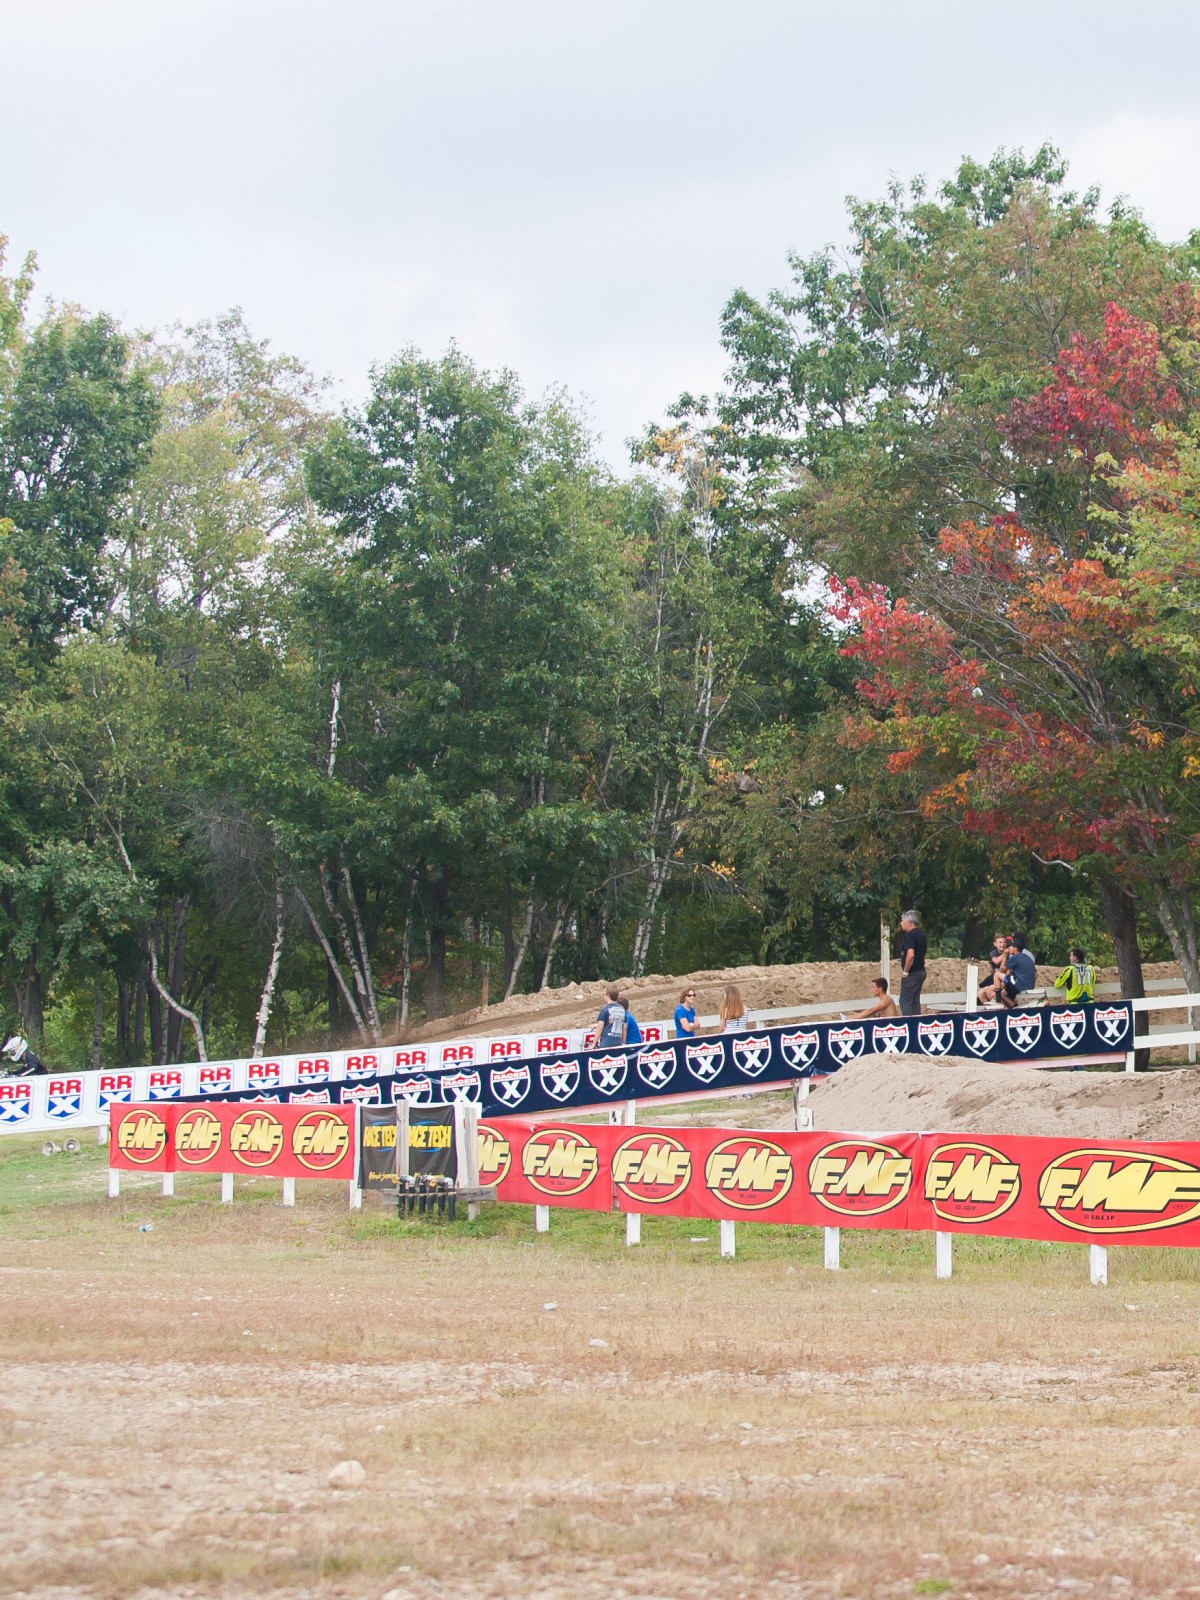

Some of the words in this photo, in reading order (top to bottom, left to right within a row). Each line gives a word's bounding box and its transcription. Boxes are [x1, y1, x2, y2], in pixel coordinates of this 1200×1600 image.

[921, 1025, 951, 1033] RACER
[966, 1022, 996, 1030] RACER
[1010, 1018, 1039, 1026] RACER
[1104, 1020, 1121, 1038] X
[784, 1036, 816, 1044] RACER
[831, 1032, 862, 1040] RACER
[876, 1028, 906, 1036] RACER
[972, 1030, 989, 1048] X
[1015, 1026, 1033, 1045] X
[1059, 1023, 1077, 1041] X
[490, 1041, 522, 1057] RR
[537, 1037, 568, 1052] RR
[735, 1041, 768, 1050] RACER
[838, 1040, 855, 1059] X
[882, 1036, 899, 1054] X
[928, 1034, 946, 1051] X
[396, 1050, 426, 1066] RR
[442, 1045, 474, 1062] RR
[640, 1053, 673, 1062] RACER
[689, 1047, 722, 1056] RACER
[743, 1050, 763, 1069] X
[791, 1044, 809, 1063] X
[248, 1062, 280, 1078] RR
[298, 1059, 330, 1075] RR
[346, 1055, 378, 1071] RR
[543, 1065, 577, 1074] RACER
[590, 1059, 624, 1068] RACER
[648, 1061, 667, 1081] X
[696, 1055, 716, 1074] X
[150, 1071, 182, 1087] RR
[200, 1066, 231, 1082] RR
[443, 1078, 477, 1087] RACER
[493, 1072, 527, 1080] RACER
[600, 1068, 618, 1087] X
[0, 1084, 31, 1099] RR
[50, 1079, 82, 1095] RR
[100, 1075, 132, 1091] RR
[395, 1083, 428, 1093] RACER
[501, 1080, 521, 1100] X
[551, 1074, 571, 1093] X
[344, 1088, 377, 1098] RACER
[452, 1086, 470, 1103] X
[48, 1095, 80, 1114] X
[118, 1117, 166, 1151] FMF
[175, 1116, 222, 1151] FMF
[230, 1118, 283, 1154] FMF
[293, 1118, 349, 1156] FMF
[478, 1134, 510, 1173] MF
[523, 1138, 598, 1178] FMF
[613, 1143, 691, 1185] FMF
[706, 1146, 792, 1192] FMF
[809, 1150, 912, 1196] FMF
[924, 1153, 1020, 1204] FMF
